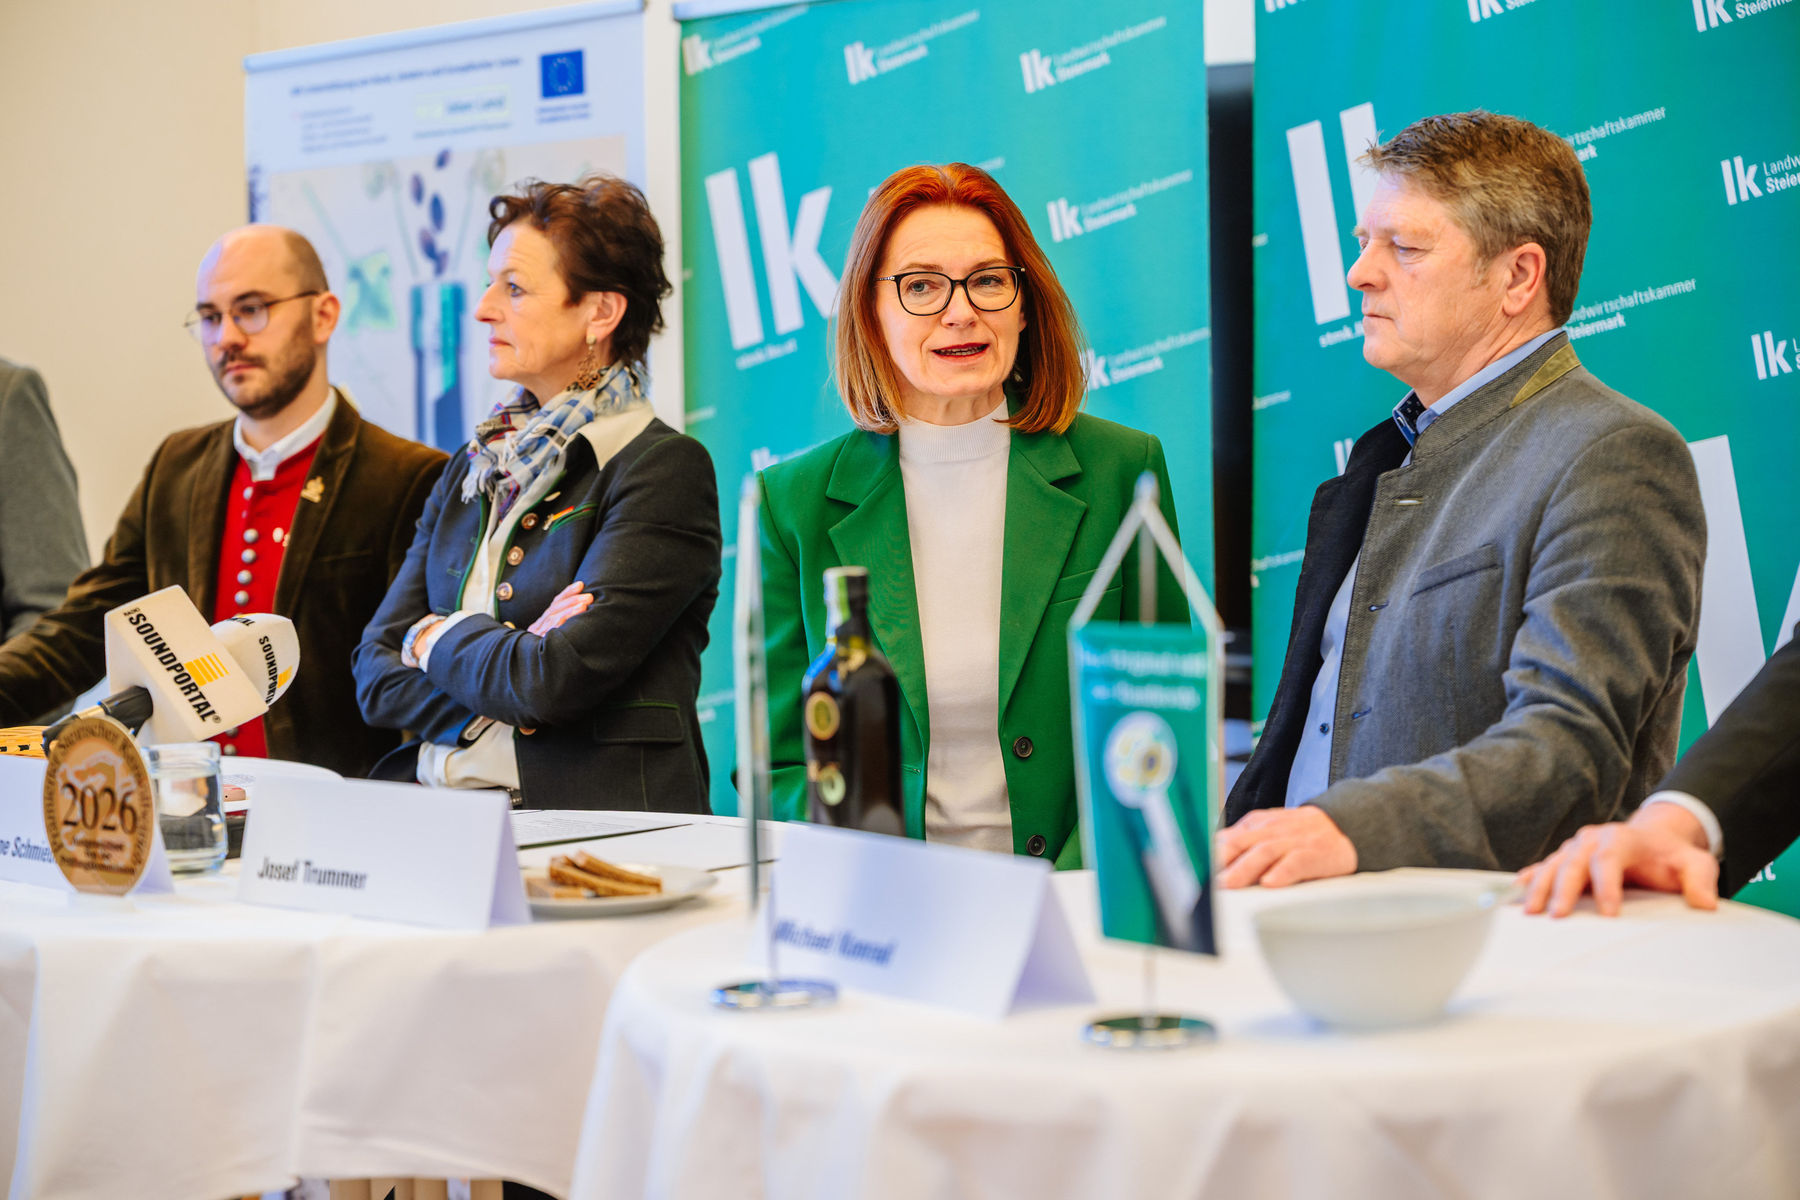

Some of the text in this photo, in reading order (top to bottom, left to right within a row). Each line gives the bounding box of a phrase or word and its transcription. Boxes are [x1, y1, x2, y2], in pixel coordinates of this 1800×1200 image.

[843, 41, 878, 85] lk
[1019, 48, 1057, 94] lk
[1720, 155, 1764, 206] lk
[1046, 197, 1084, 243] lk
[704, 150, 842, 350] lk
[1751, 330, 1793, 380] lk
[61, 783, 138, 835] 2026
[257, 857, 368, 889] Josef Trummer
